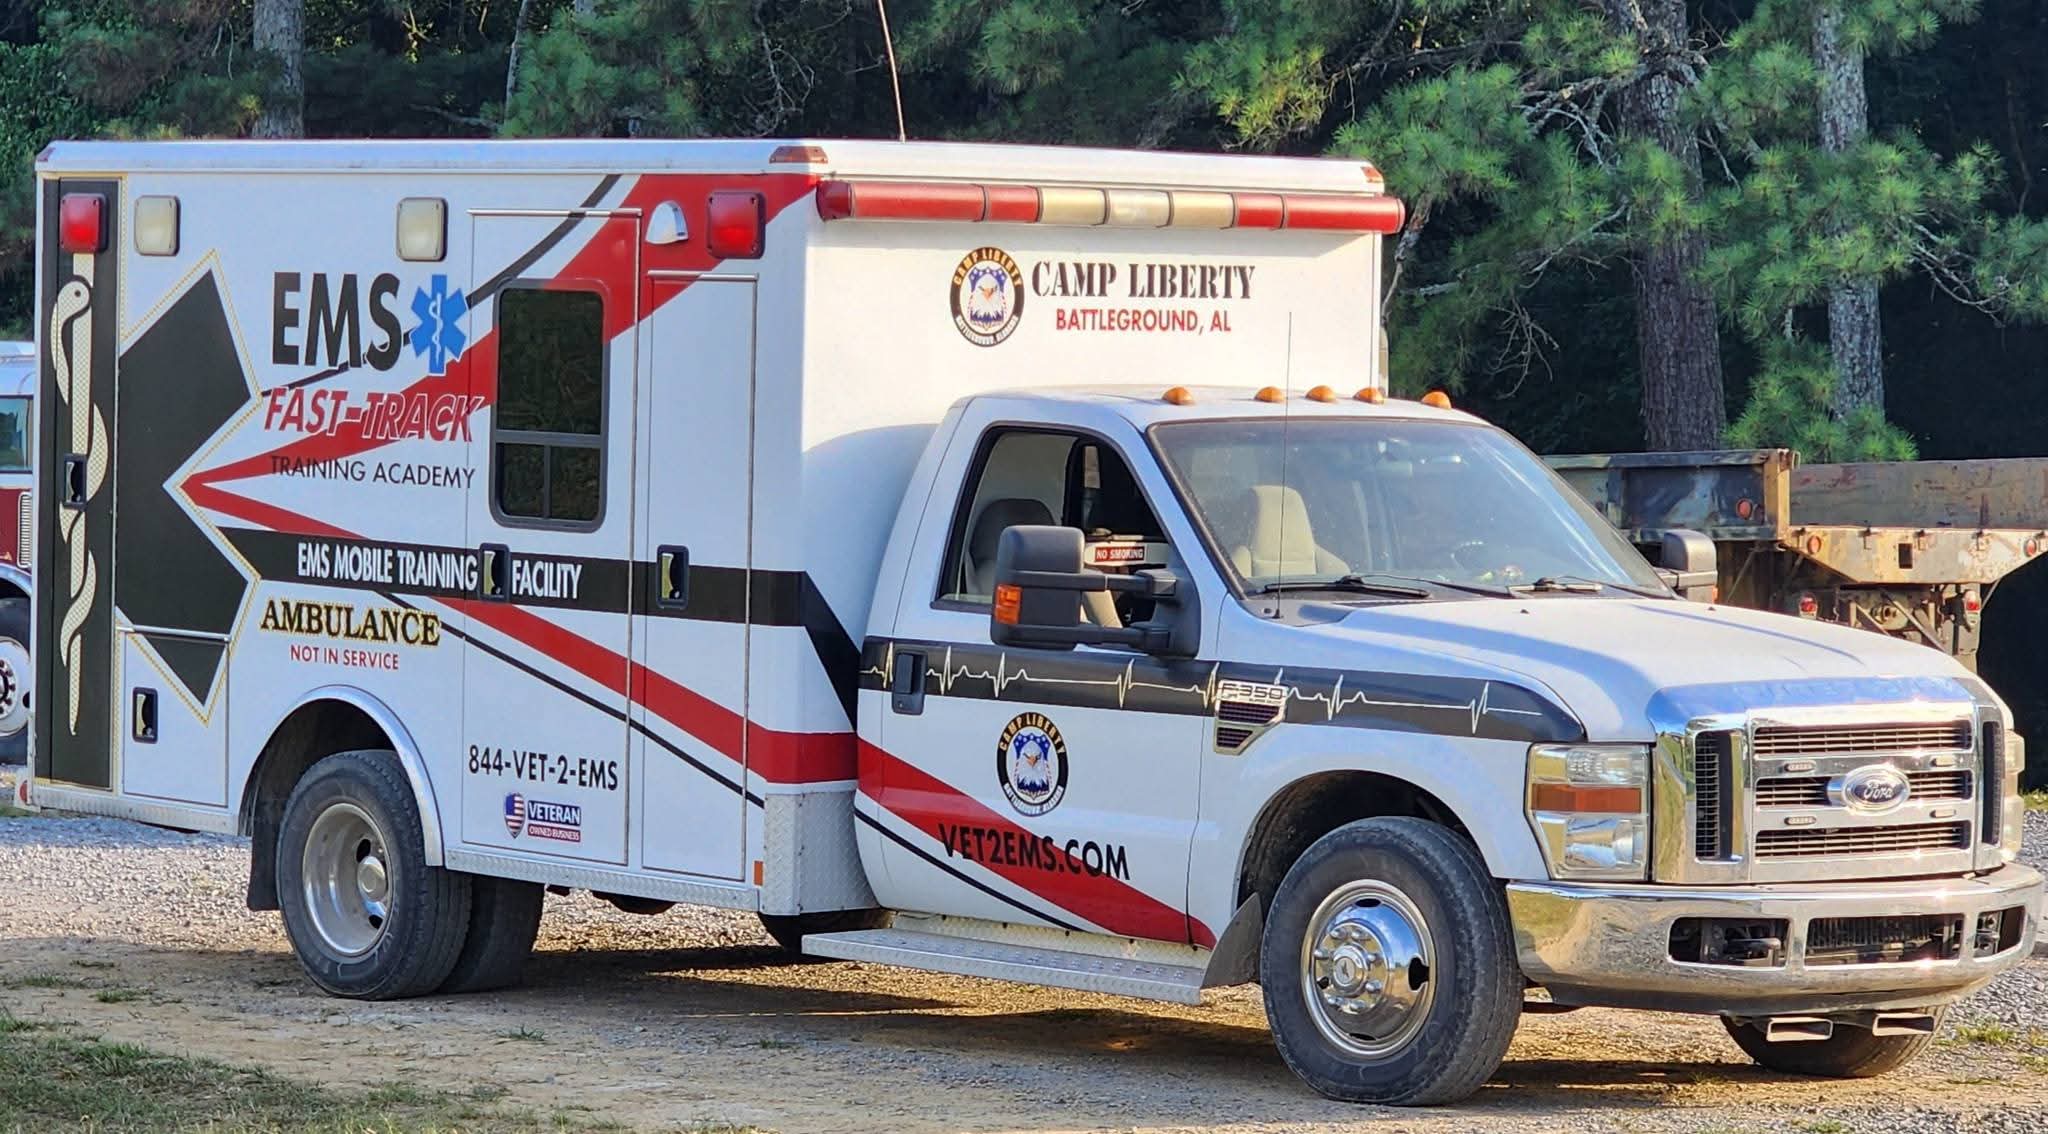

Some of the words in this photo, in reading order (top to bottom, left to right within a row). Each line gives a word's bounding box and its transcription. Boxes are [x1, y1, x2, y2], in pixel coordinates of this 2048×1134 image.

[1031, 261, 1117, 297] CAMP
[1128, 263, 1256, 299] LIBERTY
[272, 271, 401, 371] EMS
[1056, 308, 1204, 335] BATTLEGROUND,
[1210, 311, 1231, 332] AL
[264, 387, 486, 443] FAST-TRACK
[271, 455, 365, 482] TRAINING
[373, 462, 476, 488] ACADEMY
[298, 543, 329, 578] EMS
[333, 546, 393, 584] MOBILE
[397, 550, 478, 591] TRAINING
[511, 560, 583, 599] FACILITY
[1096, 548, 1108, 560] NO
[1110, 548, 1143, 560] SMOKING
[260, 599, 441, 647] AMBULANCE
[290, 645, 321, 663] NOT
[324, 648, 338, 665] IN
[343, 650, 399, 670] SERVICE
[999, 716, 1024, 751] CAMP
[1026, 714, 1067, 754] LIBERTY
[468, 744, 618, 791] 844-VET-2-EMS
[529, 802, 580, 825] VETERAN
[529, 825, 552, 837] OWNED
[938, 823, 1130, 880] VET2EMS.COM
